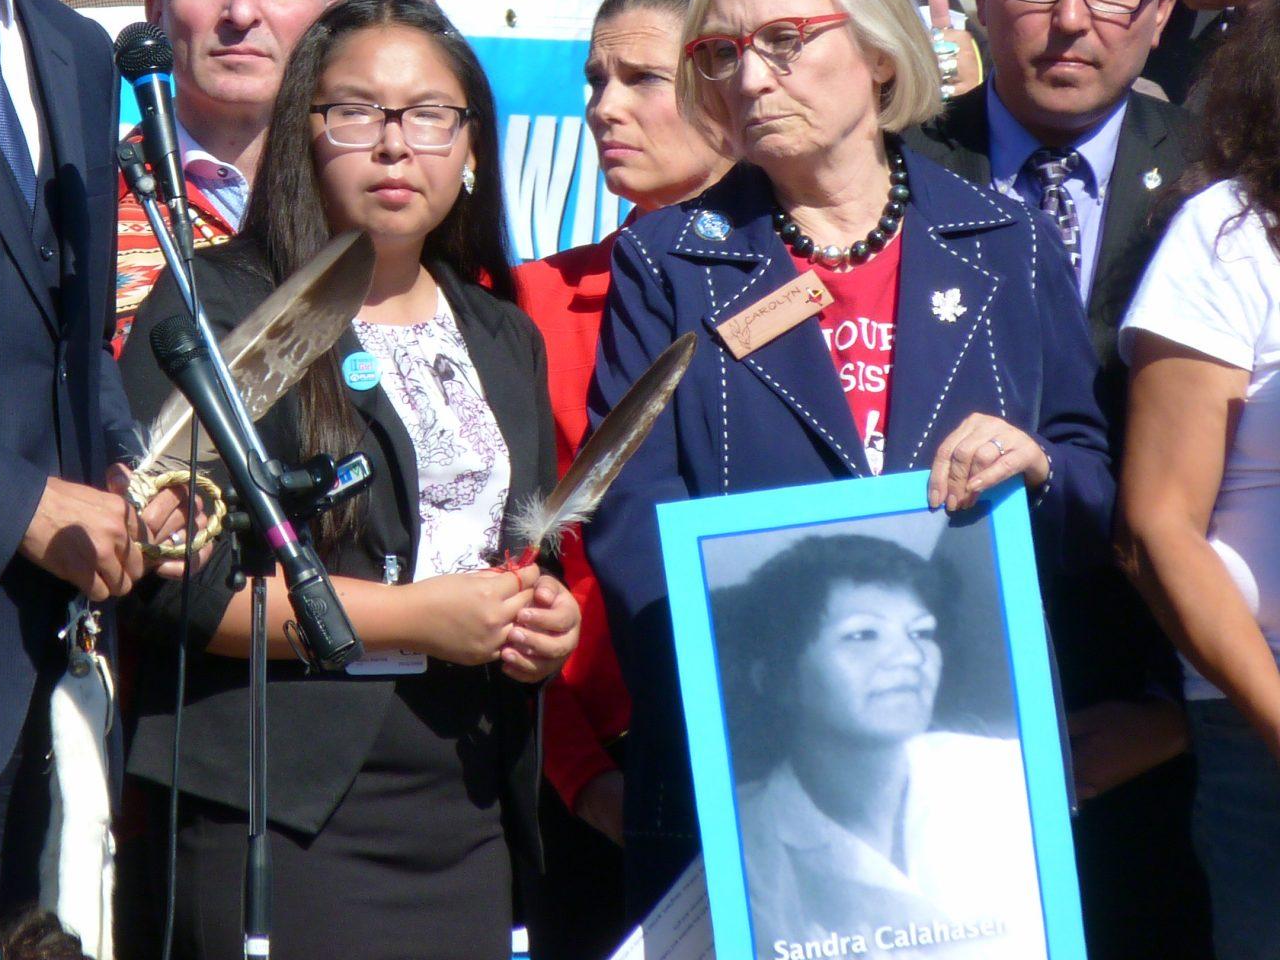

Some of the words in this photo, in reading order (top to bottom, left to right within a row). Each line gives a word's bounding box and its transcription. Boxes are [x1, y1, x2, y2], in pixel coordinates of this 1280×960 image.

[744, 286, 801, 325] CAROLYN
[840, 361, 893, 393] SIS
[773, 932, 868, 960] Sandra
